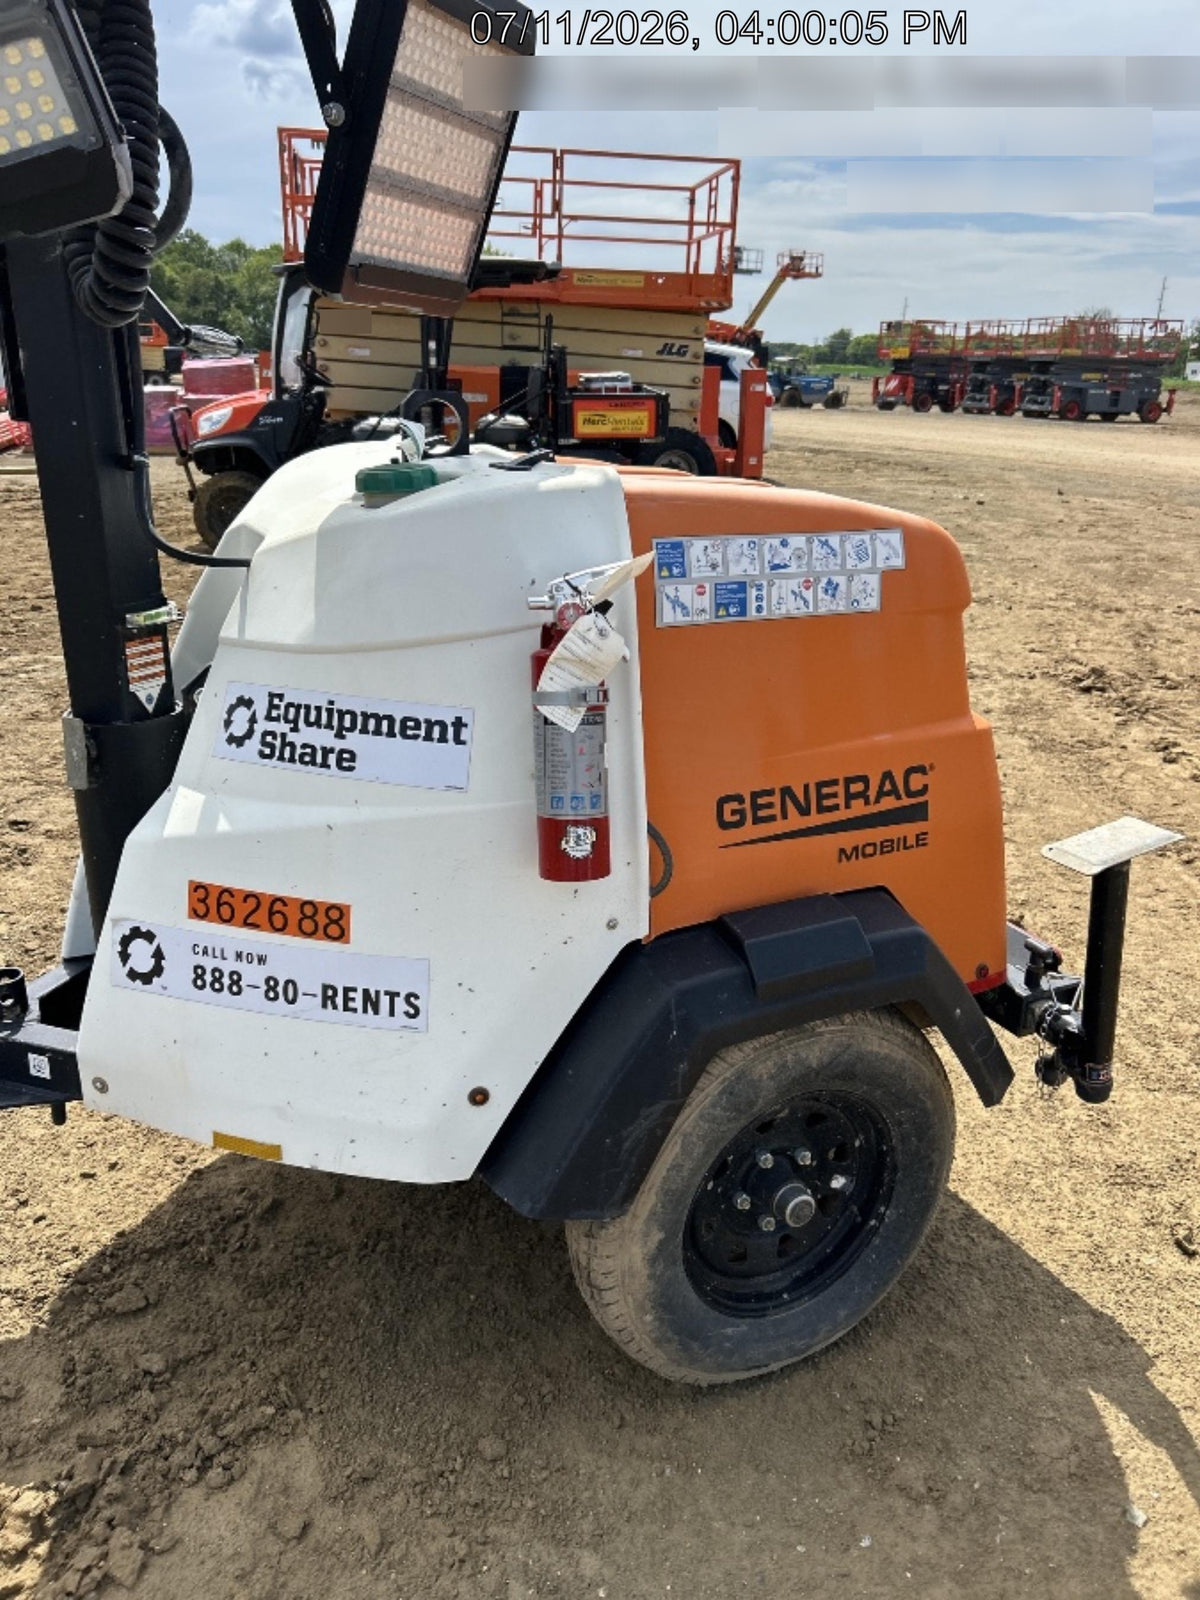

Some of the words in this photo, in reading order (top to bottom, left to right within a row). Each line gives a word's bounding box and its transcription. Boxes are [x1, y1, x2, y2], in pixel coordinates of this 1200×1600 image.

[656, 342, 690, 358] JLG
[263, 691, 469, 746] Equipment
[257, 729, 357, 773] Share
[716, 764, 930, 831] GENERAC
[837, 831, 929, 864] MOBILE
[191, 883, 347, 941] 362688
[191, 942, 229, 961] CALL
[234, 949, 268, 967] NOW
[191, 963, 421, 1020] 888-80-RENTS
